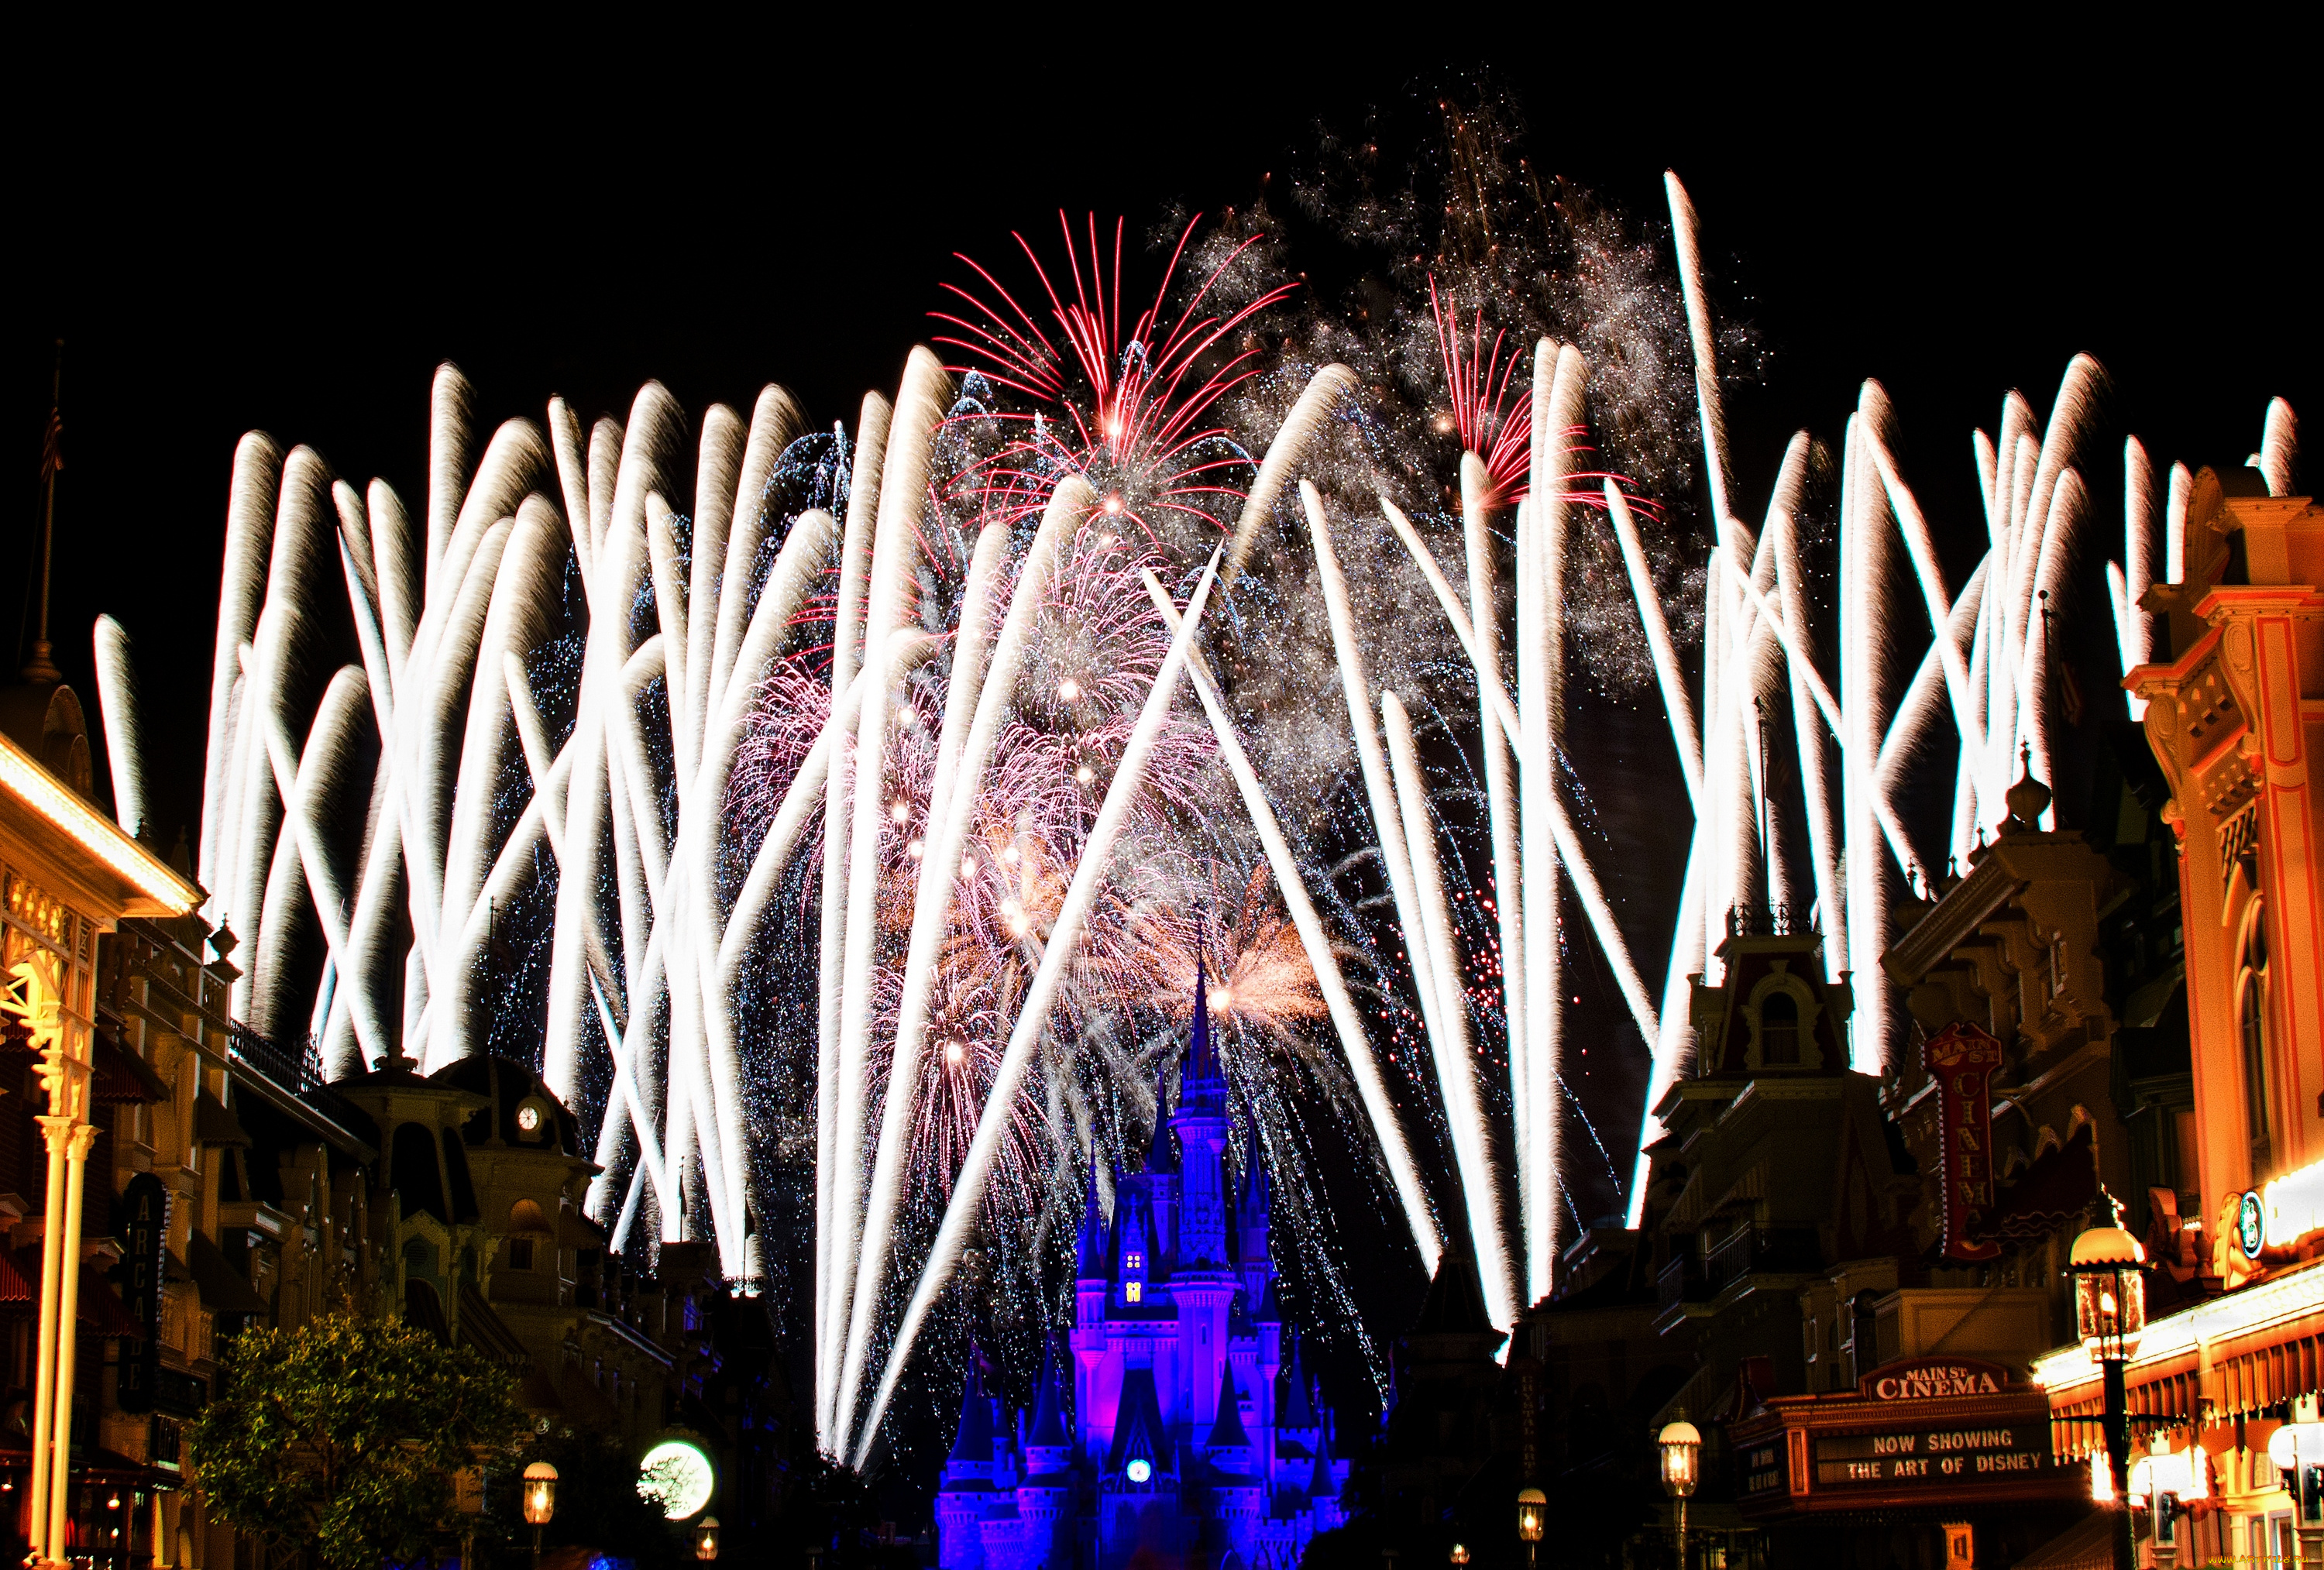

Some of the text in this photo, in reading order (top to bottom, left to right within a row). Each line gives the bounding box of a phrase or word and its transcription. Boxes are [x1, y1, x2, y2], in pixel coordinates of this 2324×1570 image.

[1932, 1038, 1991, 1062] MAIN
[1952, 1072, 1988, 1233] CINEMA
[1876, 1372, 2000, 1399] CINEMA
[1906, 1366, 1946, 1380] MAIN
[1874, 1429, 2013, 1454] NOW SHOWING
[1847, 1451, 2041, 1479] THE ART OF DISNEY
